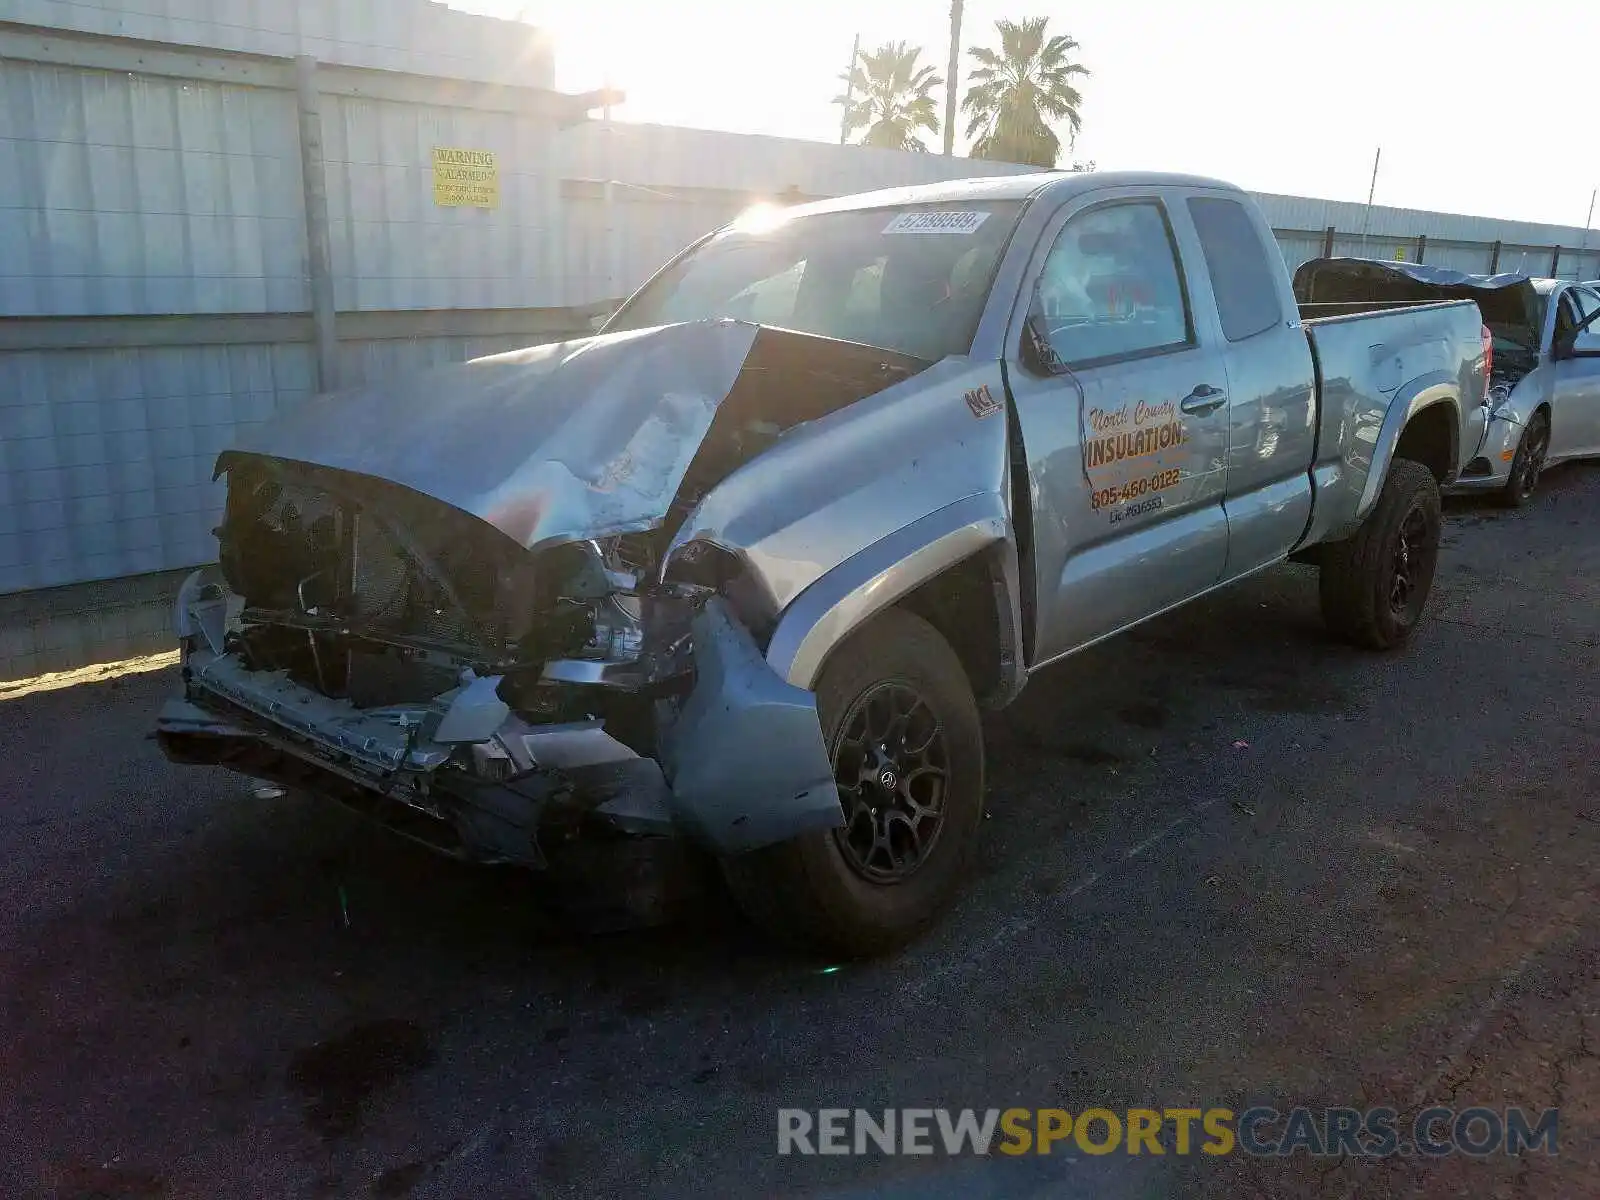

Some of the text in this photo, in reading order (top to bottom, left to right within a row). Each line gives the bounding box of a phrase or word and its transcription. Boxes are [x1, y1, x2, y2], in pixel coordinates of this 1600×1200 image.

[437, 150, 493, 166] WARNING
[1090, 400, 1175, 431] North County
[1087, 420, 1183, 468] INSULATION
[1091, 468, 1181, 510] 805-460-0122
